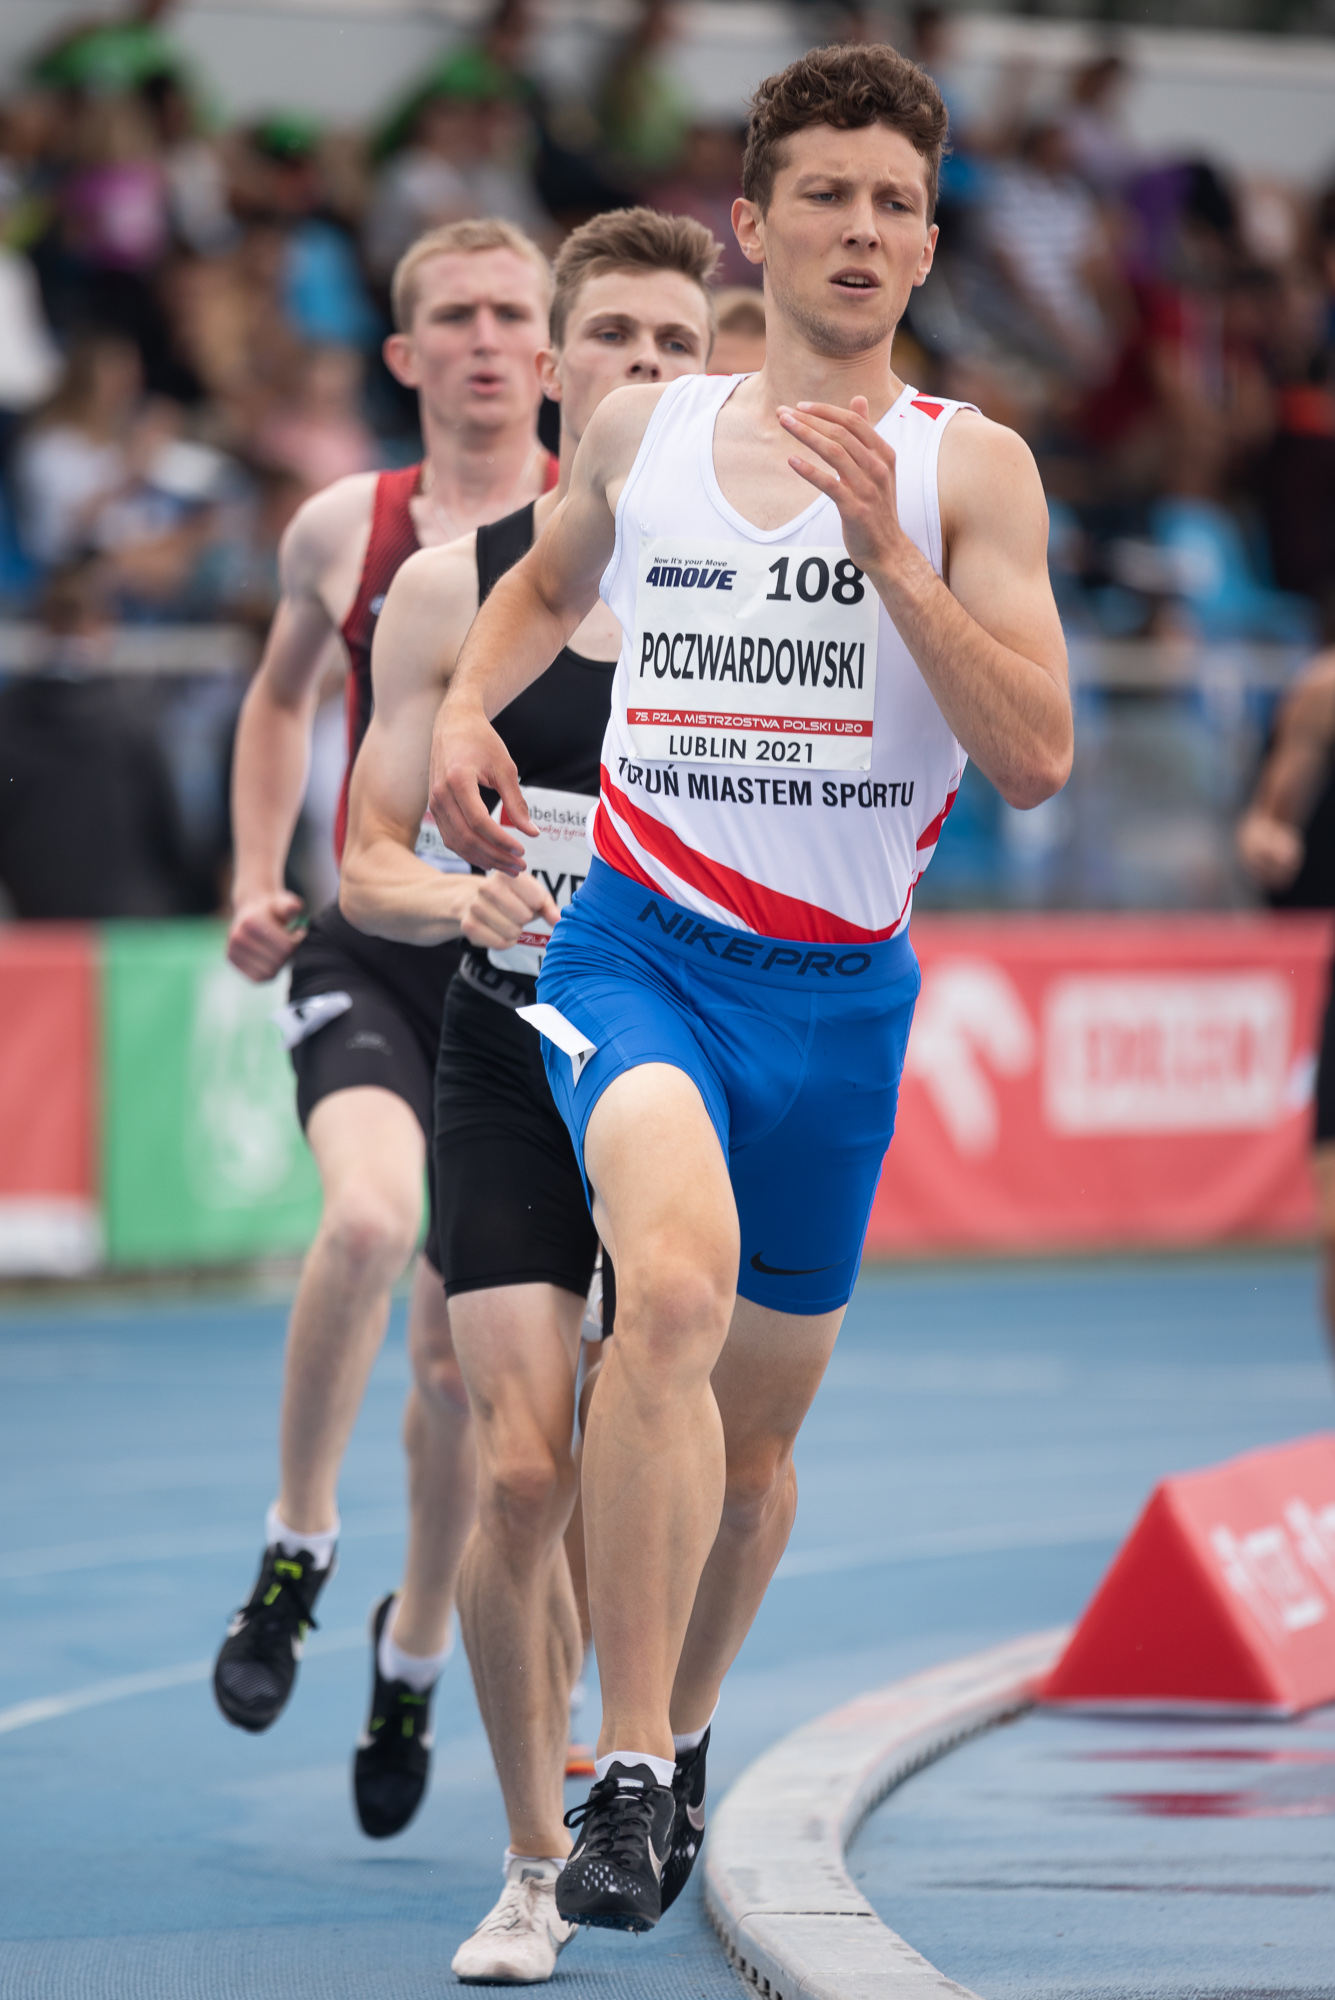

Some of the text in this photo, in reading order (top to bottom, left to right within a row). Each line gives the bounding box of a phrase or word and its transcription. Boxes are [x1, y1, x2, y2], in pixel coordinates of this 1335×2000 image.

[671, 557, 682, 565] It's
[684, 559, 703, 567] your
[705, 559, 728, 567] Move
[646, 566, 737, 591] 4MOVE
[766, 556, 865, 605] 108
[639, 632, 865, 690] POCZWARDOWSKI
[635, 711, 863, 734] 75. PZLA MISTRZOSTWA POLSKI U20
[669, 735, 813, 764] LUBLIN 2021
[687, 773, 813, 806] MIASTEM
[822, 780, 915, 808] SPORTU
[636, 899, 872, 977] NIKE PRO
